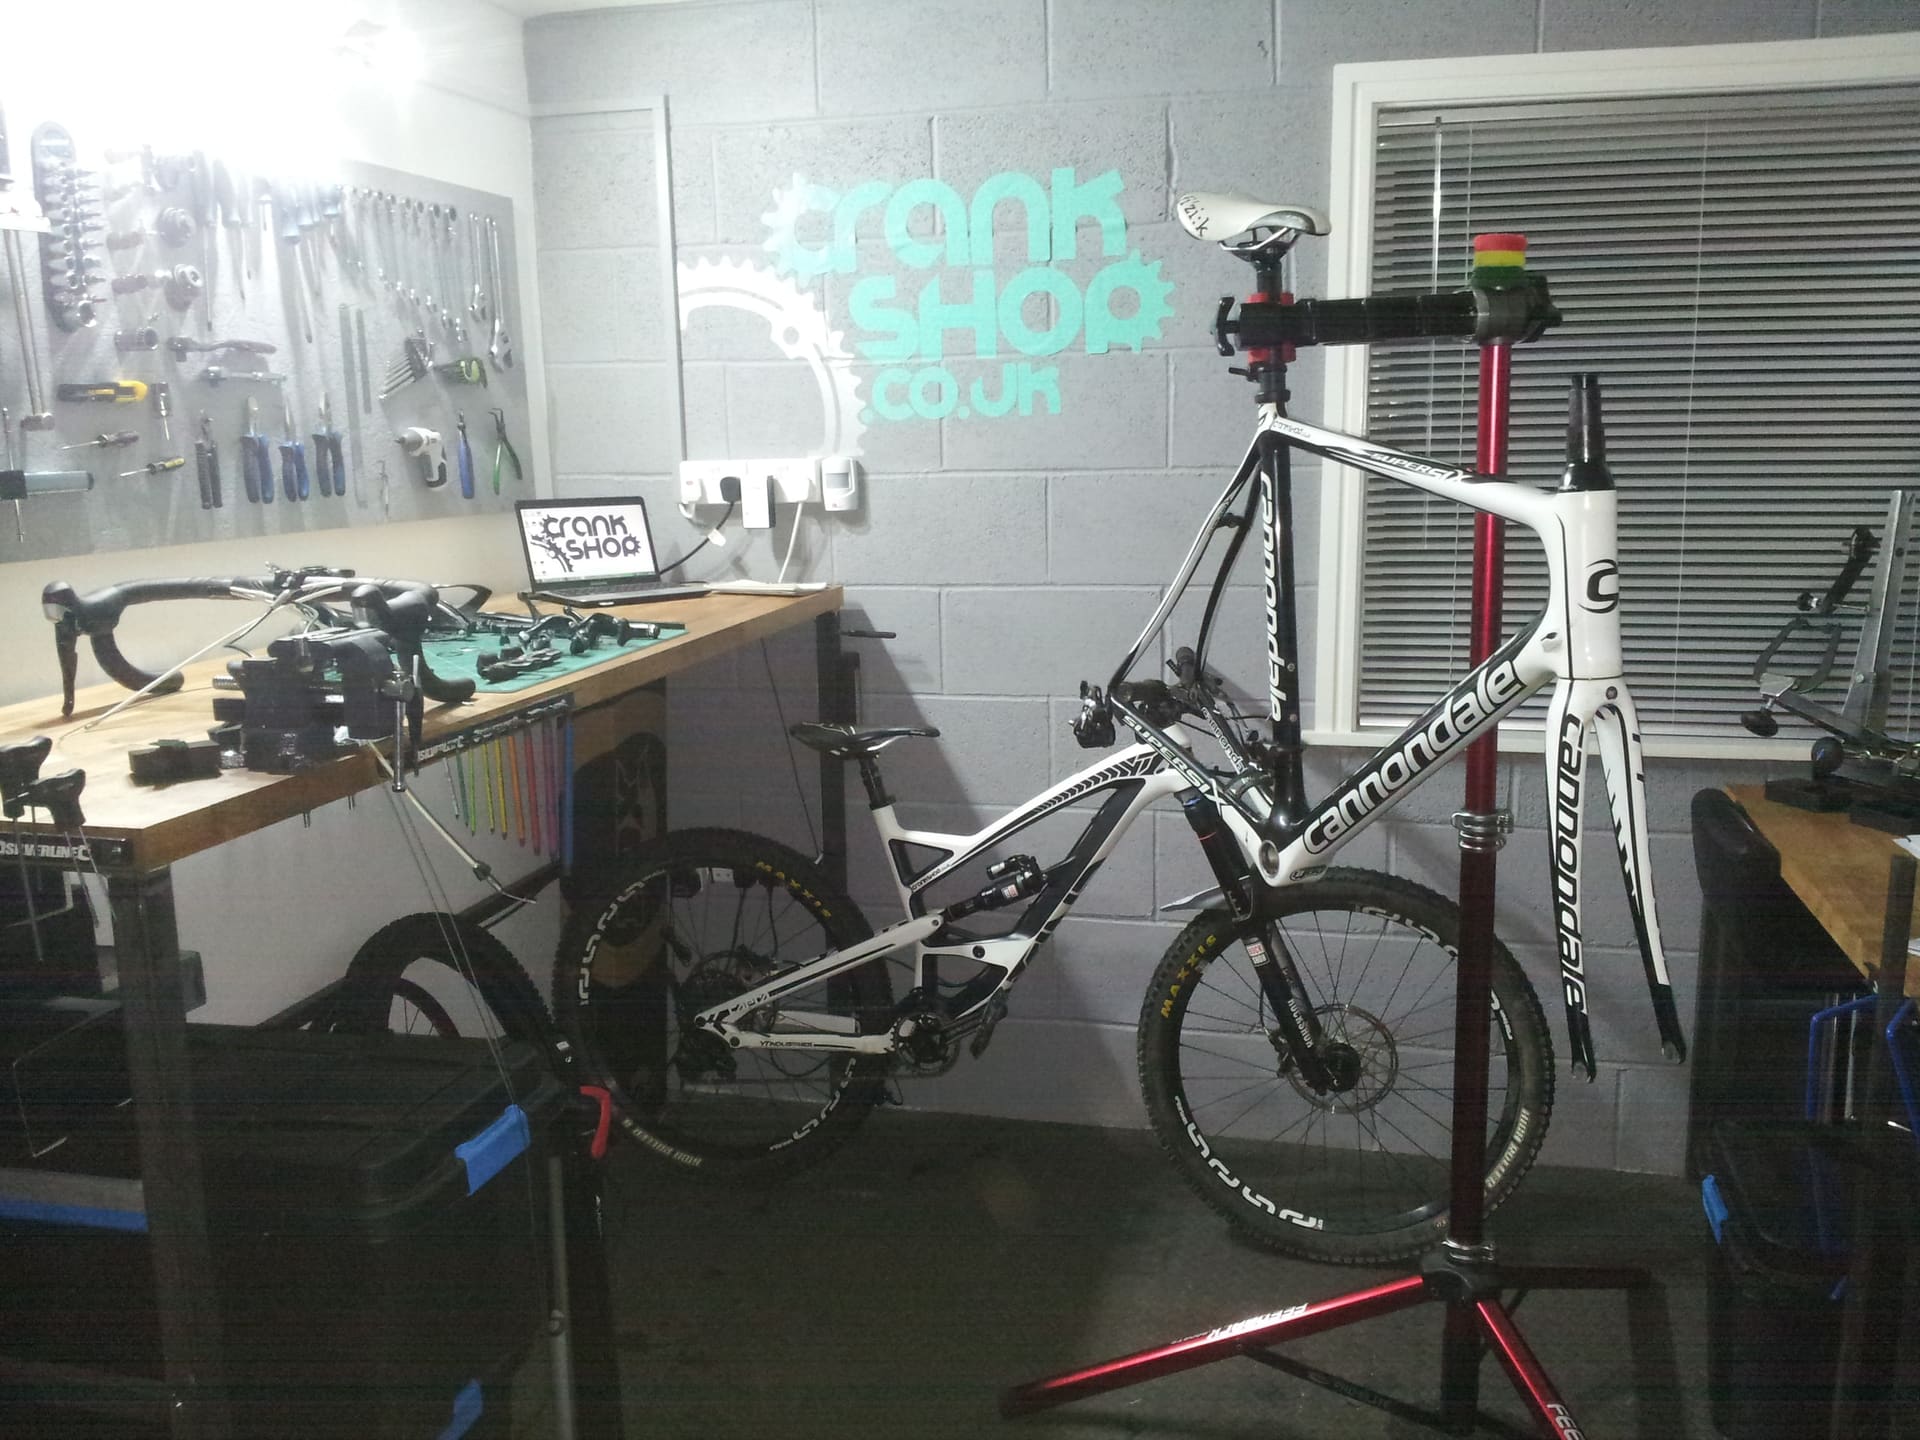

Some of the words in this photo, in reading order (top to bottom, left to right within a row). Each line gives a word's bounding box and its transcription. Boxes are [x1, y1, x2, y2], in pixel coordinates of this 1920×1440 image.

[1260, 470, 1288, 723] cannondale
[1302, 660, 1527, 855] cannondale
[1557, 712, 1589, 1016] cannondale
[1160, 934, 1217, 1019] MAXXIS
